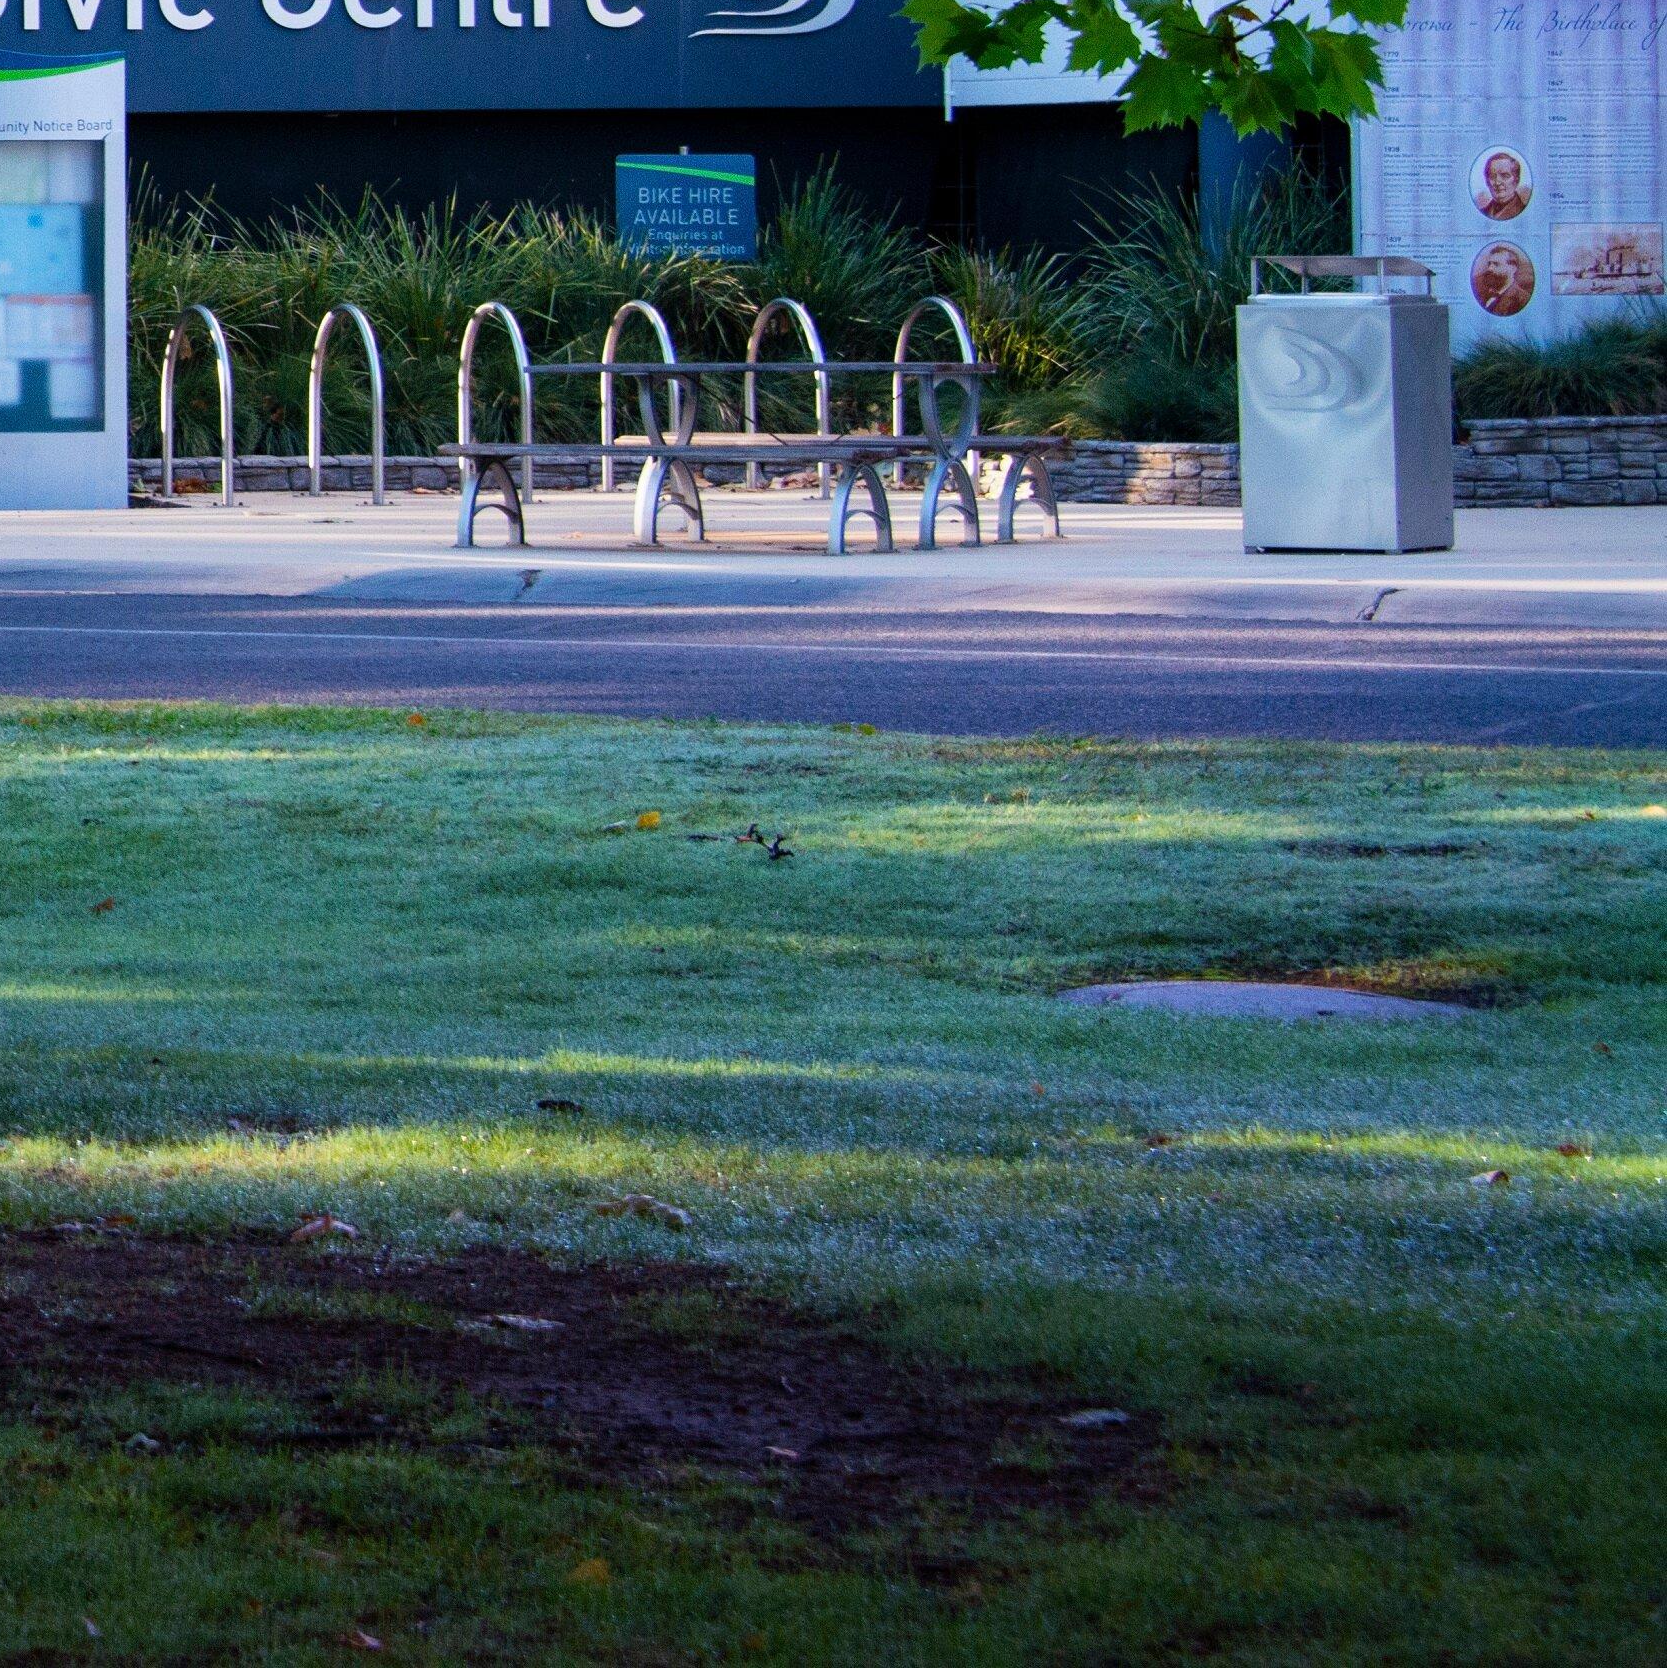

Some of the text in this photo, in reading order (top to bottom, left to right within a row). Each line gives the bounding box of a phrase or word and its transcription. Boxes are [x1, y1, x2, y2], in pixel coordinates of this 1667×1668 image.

[1493, 3, 1525, 32] The
[1536, 3, 1637, 49] Birthplace
[33, 120, 73, 133] Notice
[77, 119, 112, 132] Board
[638, 187, 734, 204] BIKE HIRE
[633, 208, 739, 225] AVAILABLE
[648, 228, 724, 242] Enquiries at
